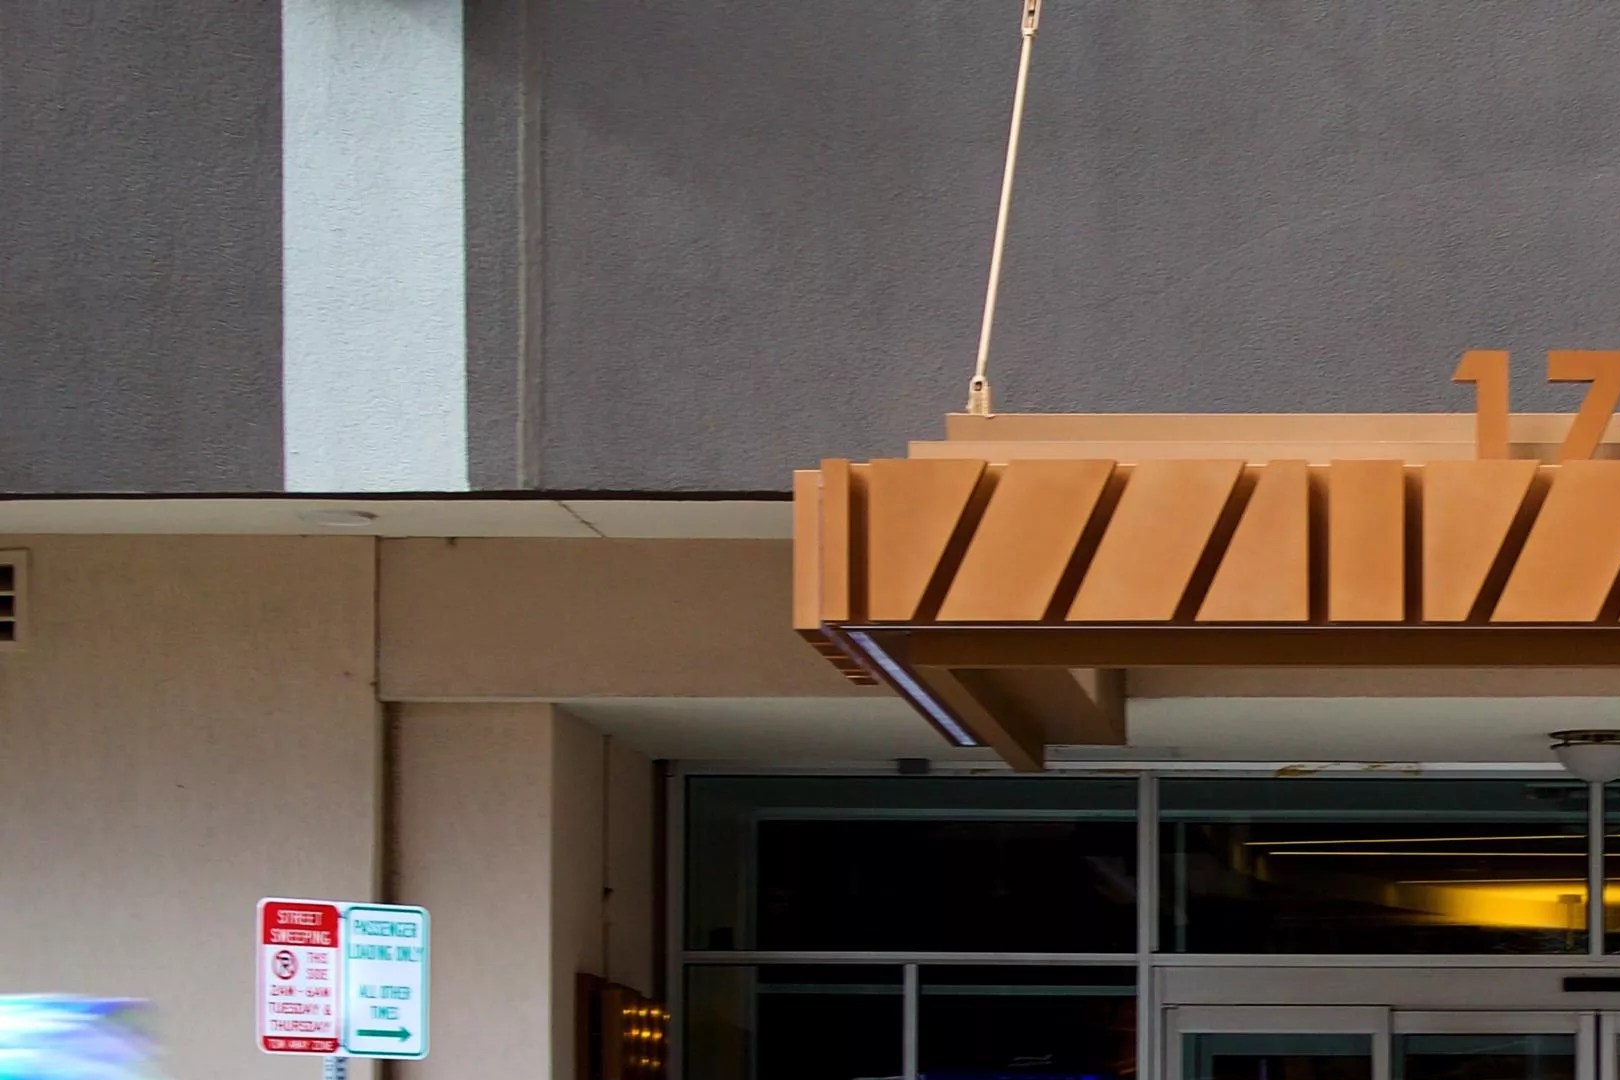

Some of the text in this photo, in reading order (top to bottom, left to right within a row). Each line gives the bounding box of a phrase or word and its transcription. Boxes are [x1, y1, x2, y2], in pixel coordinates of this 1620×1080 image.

[277, 910, 323, 926] STREET
[354, 919, 418, 938] PASSENGER
[270, 929, 332, 945] SWEEPING
[306, 952, 328, 964] THIS
[348, 944, 424, 962] LOADING ONLY
[306, 968, 328, 980] SIDE
[359, 984, 411, 1000] ALL OTHER
[269, 1001, 319, 1015] TUESDAY
[269, 1019, 331, 1032] THURSDAY
